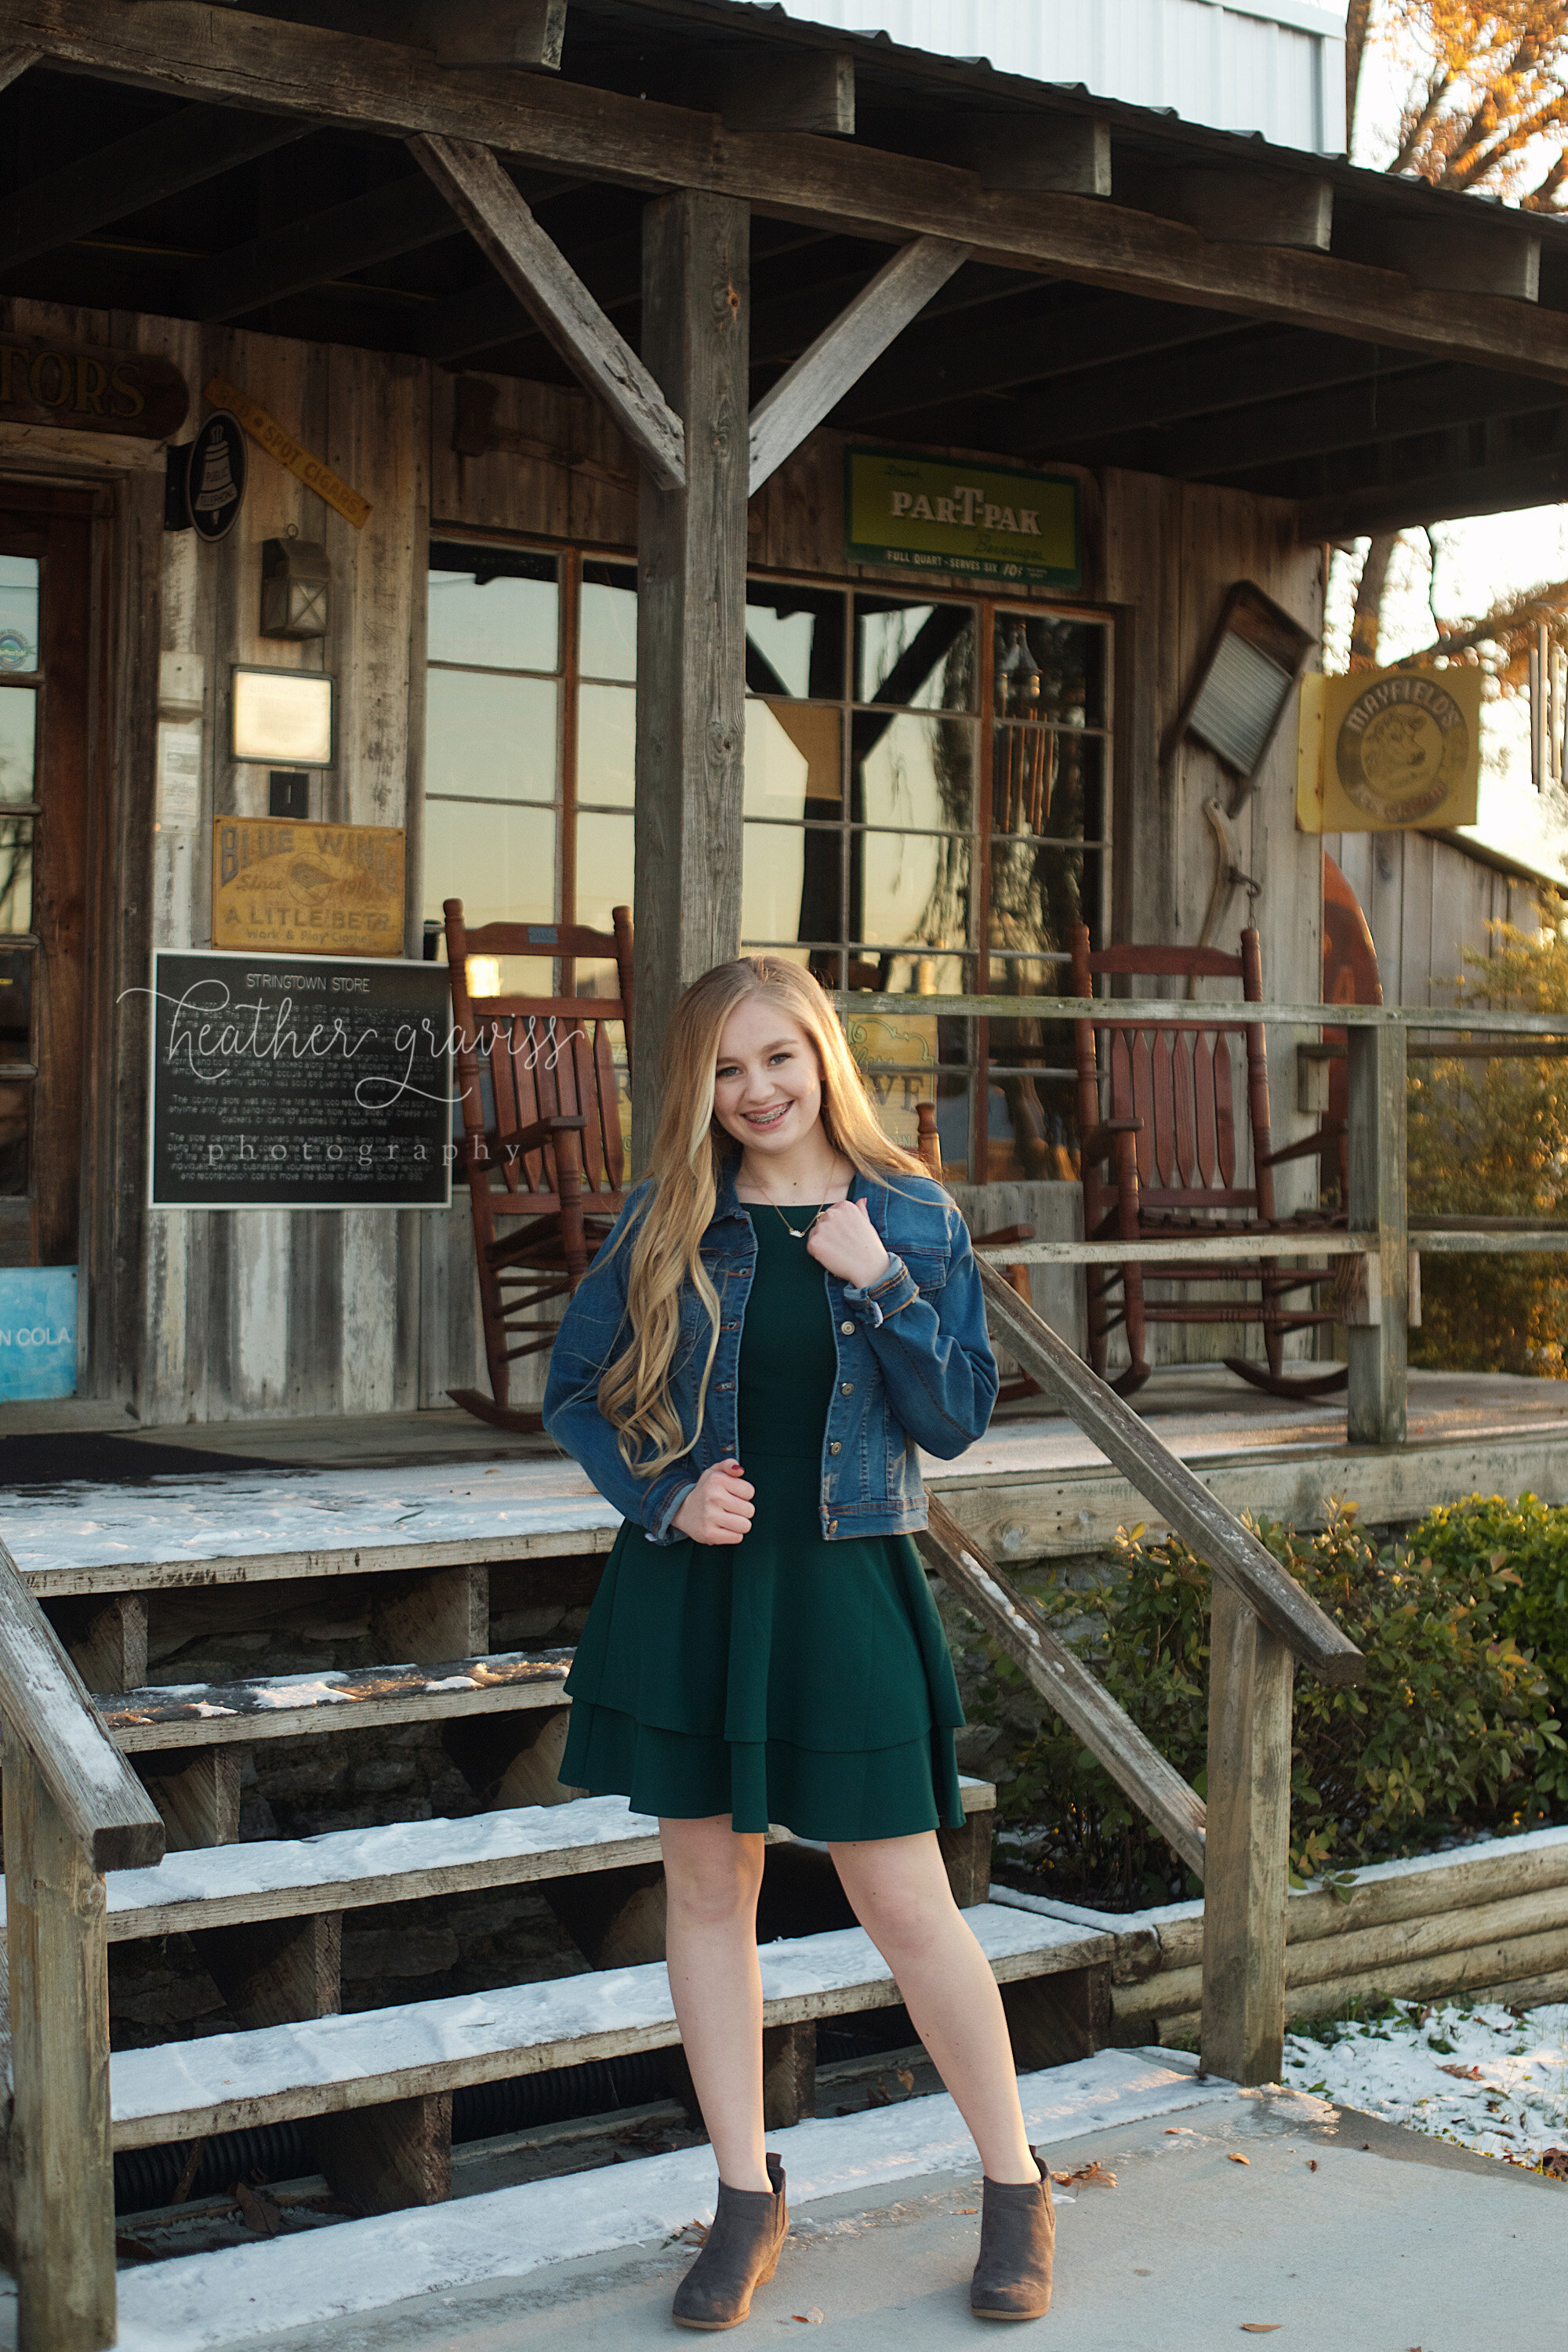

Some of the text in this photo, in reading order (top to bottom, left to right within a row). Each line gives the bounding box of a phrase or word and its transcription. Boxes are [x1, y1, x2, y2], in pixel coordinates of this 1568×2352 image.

[0, 347, 144, 417] TORS
[263, 425, 303, 466] SPOT
[304, 462, 361, 514] CIGARS
[887, 550, 910, 563] FULL
[913, 553, 942, 566] QUART
[949, 557, 982, 571] SERVES
[983, 561, 999, 573] SIX
[220, 825, 296, 888] BLUE
[225, 906, 241, 924] A
[246, 927, 278, 940] Work
[285, 929, 295, 940] &
[301, 931, 328, 945] Play
[246, 973, 371, 992] STRINGTOWN STORE
[16, 1327, 71, 1347] COLA
